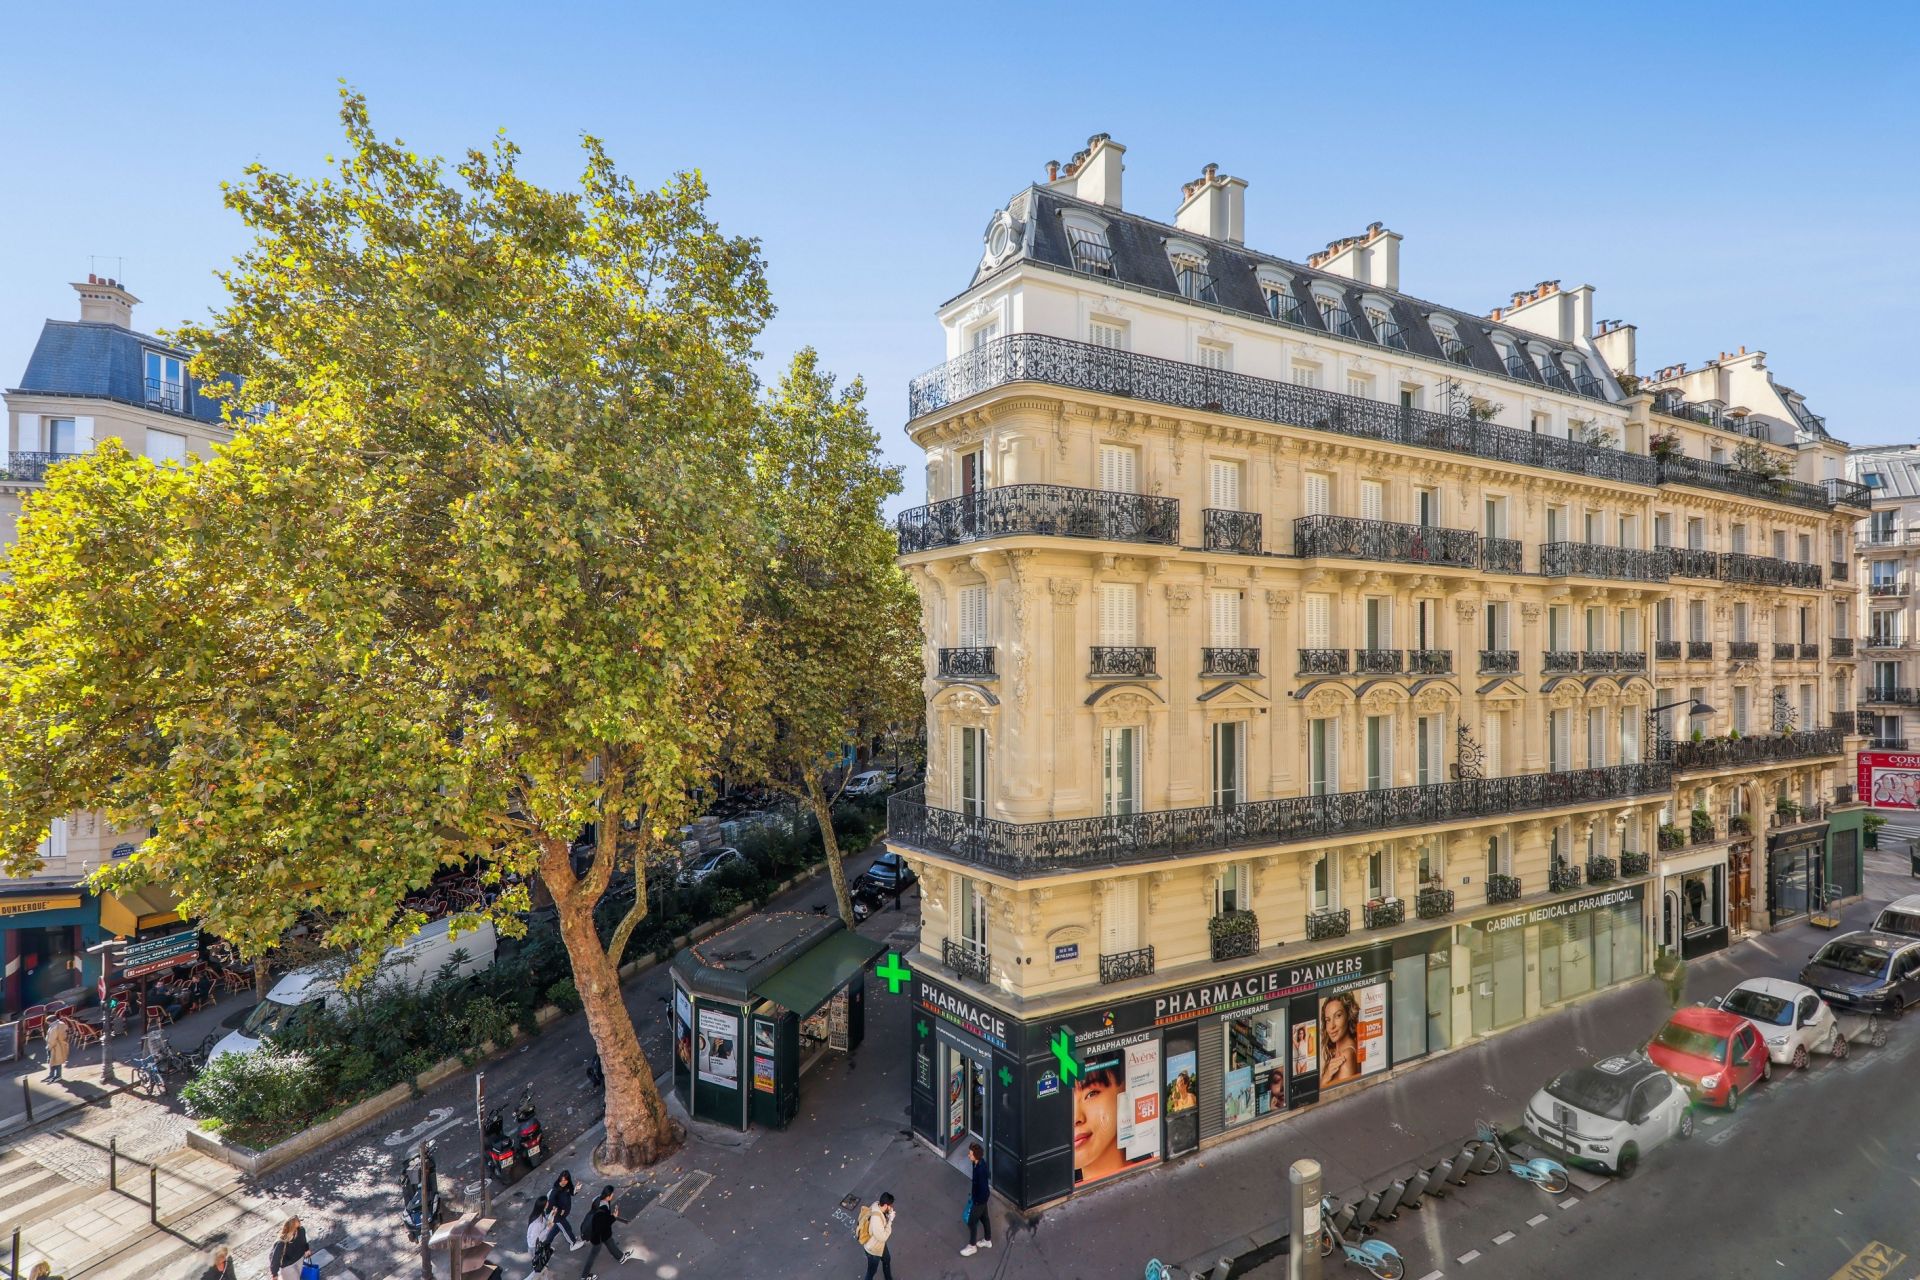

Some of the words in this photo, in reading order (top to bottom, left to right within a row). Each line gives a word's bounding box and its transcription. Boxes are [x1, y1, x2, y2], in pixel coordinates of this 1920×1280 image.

[1487, 913, 1526, 933] CABINET
[1529, 904, 1568, 923] MEDICAL
[1569, 903, 1577, 913] et
[1578, 889, 1634, 911] PARAMEDICAL
[1155, 973, 1278, 1017] PHARMACIE
[1291, 956, 1363, 984] D'ANVERS
[1332, 977, 1377, 994] AROMATHERAPIE
[921, 983, 1005, 1038] PHARMACIE
[1221, 1003, 1270, 1021] PHYTOTHERAPIE
[1075, 1025, 1115, 1043] eadersanté
[1086, 1033, 1150, 1055] PARAPHARMACIE
